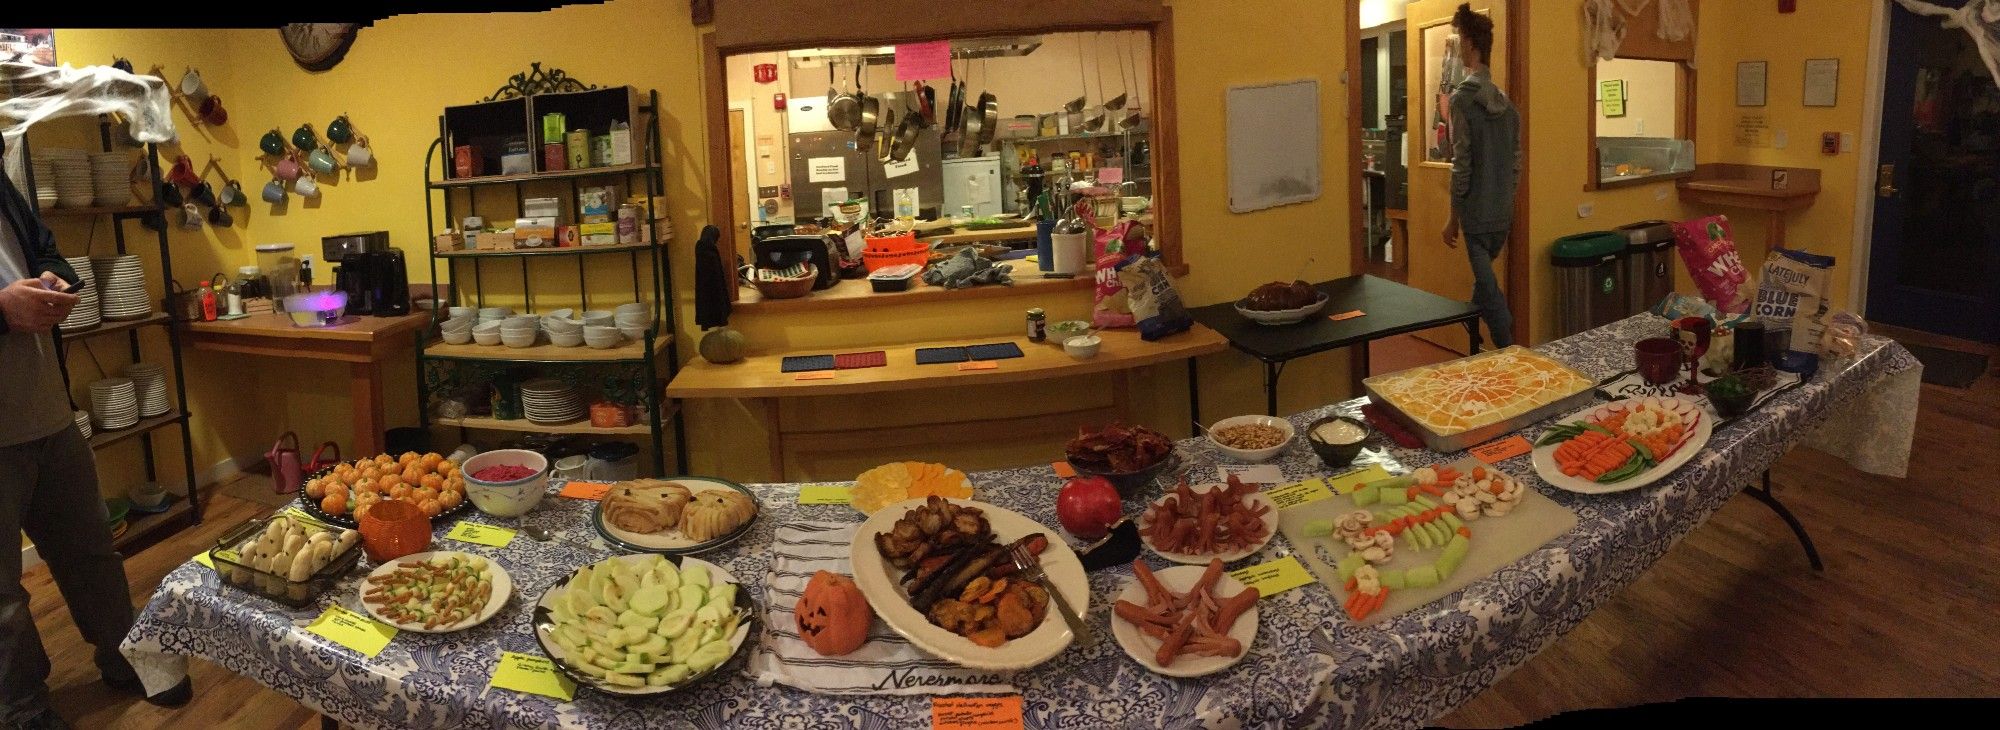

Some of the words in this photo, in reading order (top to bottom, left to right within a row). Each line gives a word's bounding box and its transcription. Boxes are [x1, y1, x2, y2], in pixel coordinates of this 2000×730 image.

[1757, 288, 1799, 307] BLUE
[1755, 303, 1797, 318] CORN
[872, 666, 1002, 691] Nevermore
